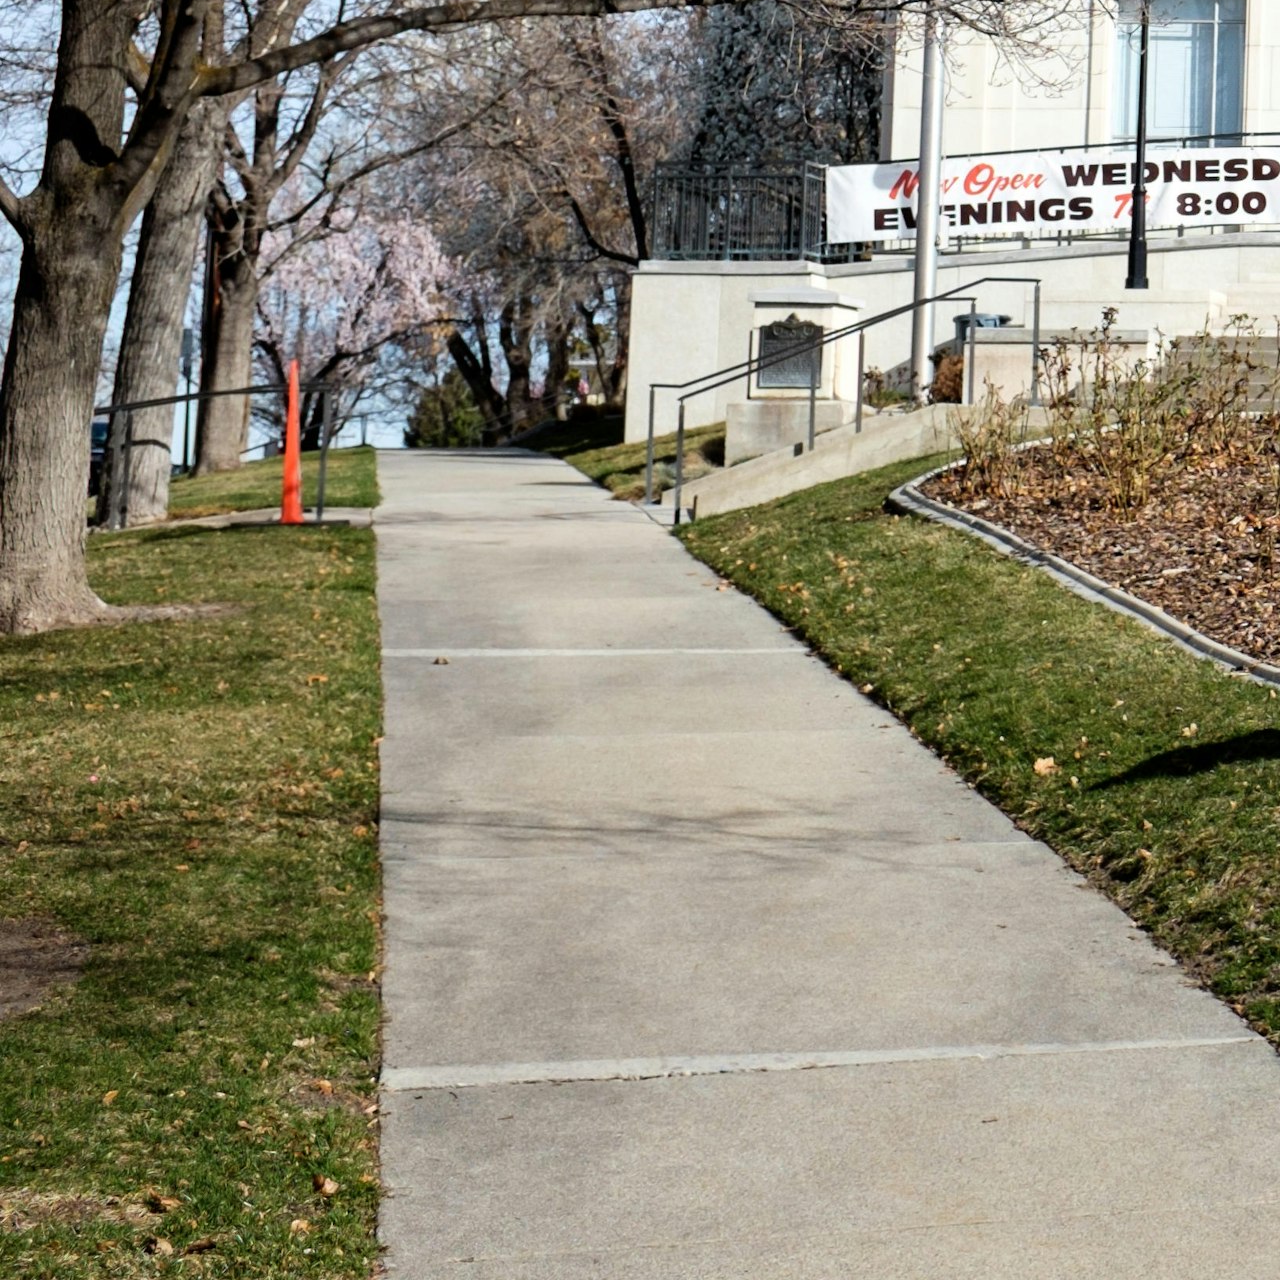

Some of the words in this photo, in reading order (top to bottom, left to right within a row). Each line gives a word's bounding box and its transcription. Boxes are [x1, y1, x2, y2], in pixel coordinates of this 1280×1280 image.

[889, 169, 959, 200] Nw
[963, 162, 1047, 201] Open
[1176, 191, 1267, 216] 8:00
